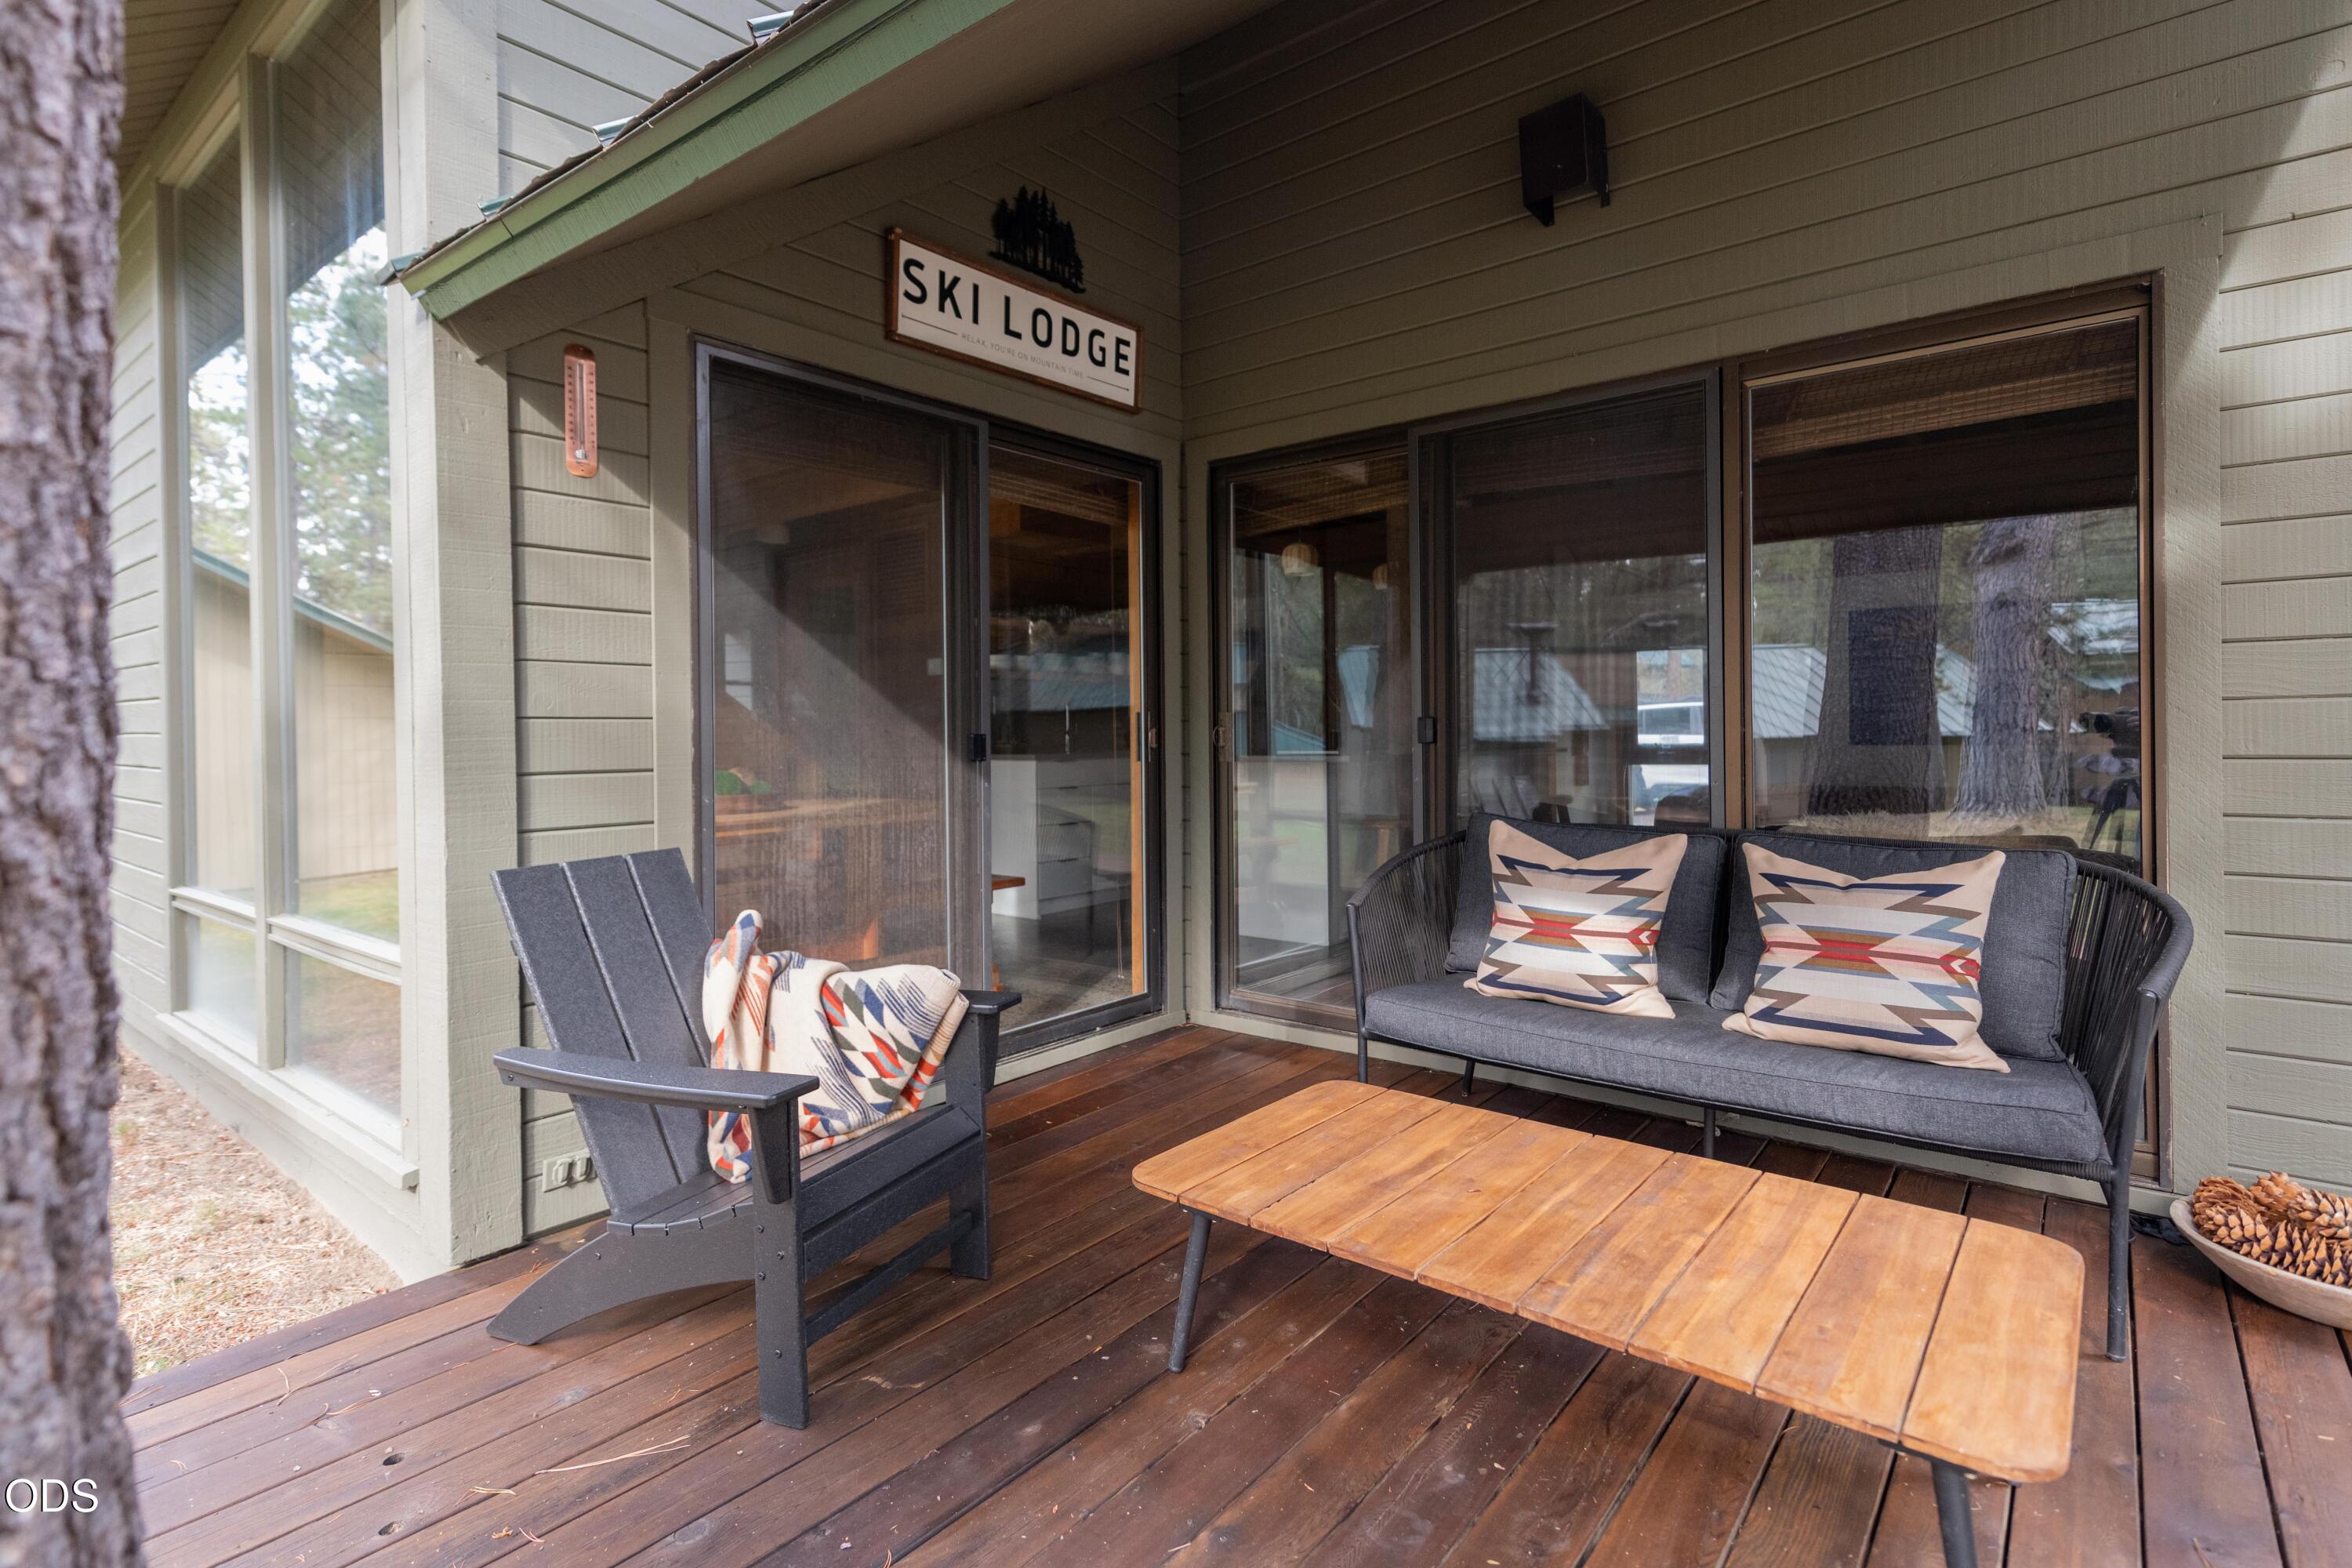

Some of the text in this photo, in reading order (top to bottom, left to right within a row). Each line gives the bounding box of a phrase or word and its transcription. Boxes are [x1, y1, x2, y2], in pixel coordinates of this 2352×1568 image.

[902, 258, 1131, 376] SKI LODGE
[961, 332, 1083, 379] RELAX, YOU'RE ON MOUNTAIN TIME
